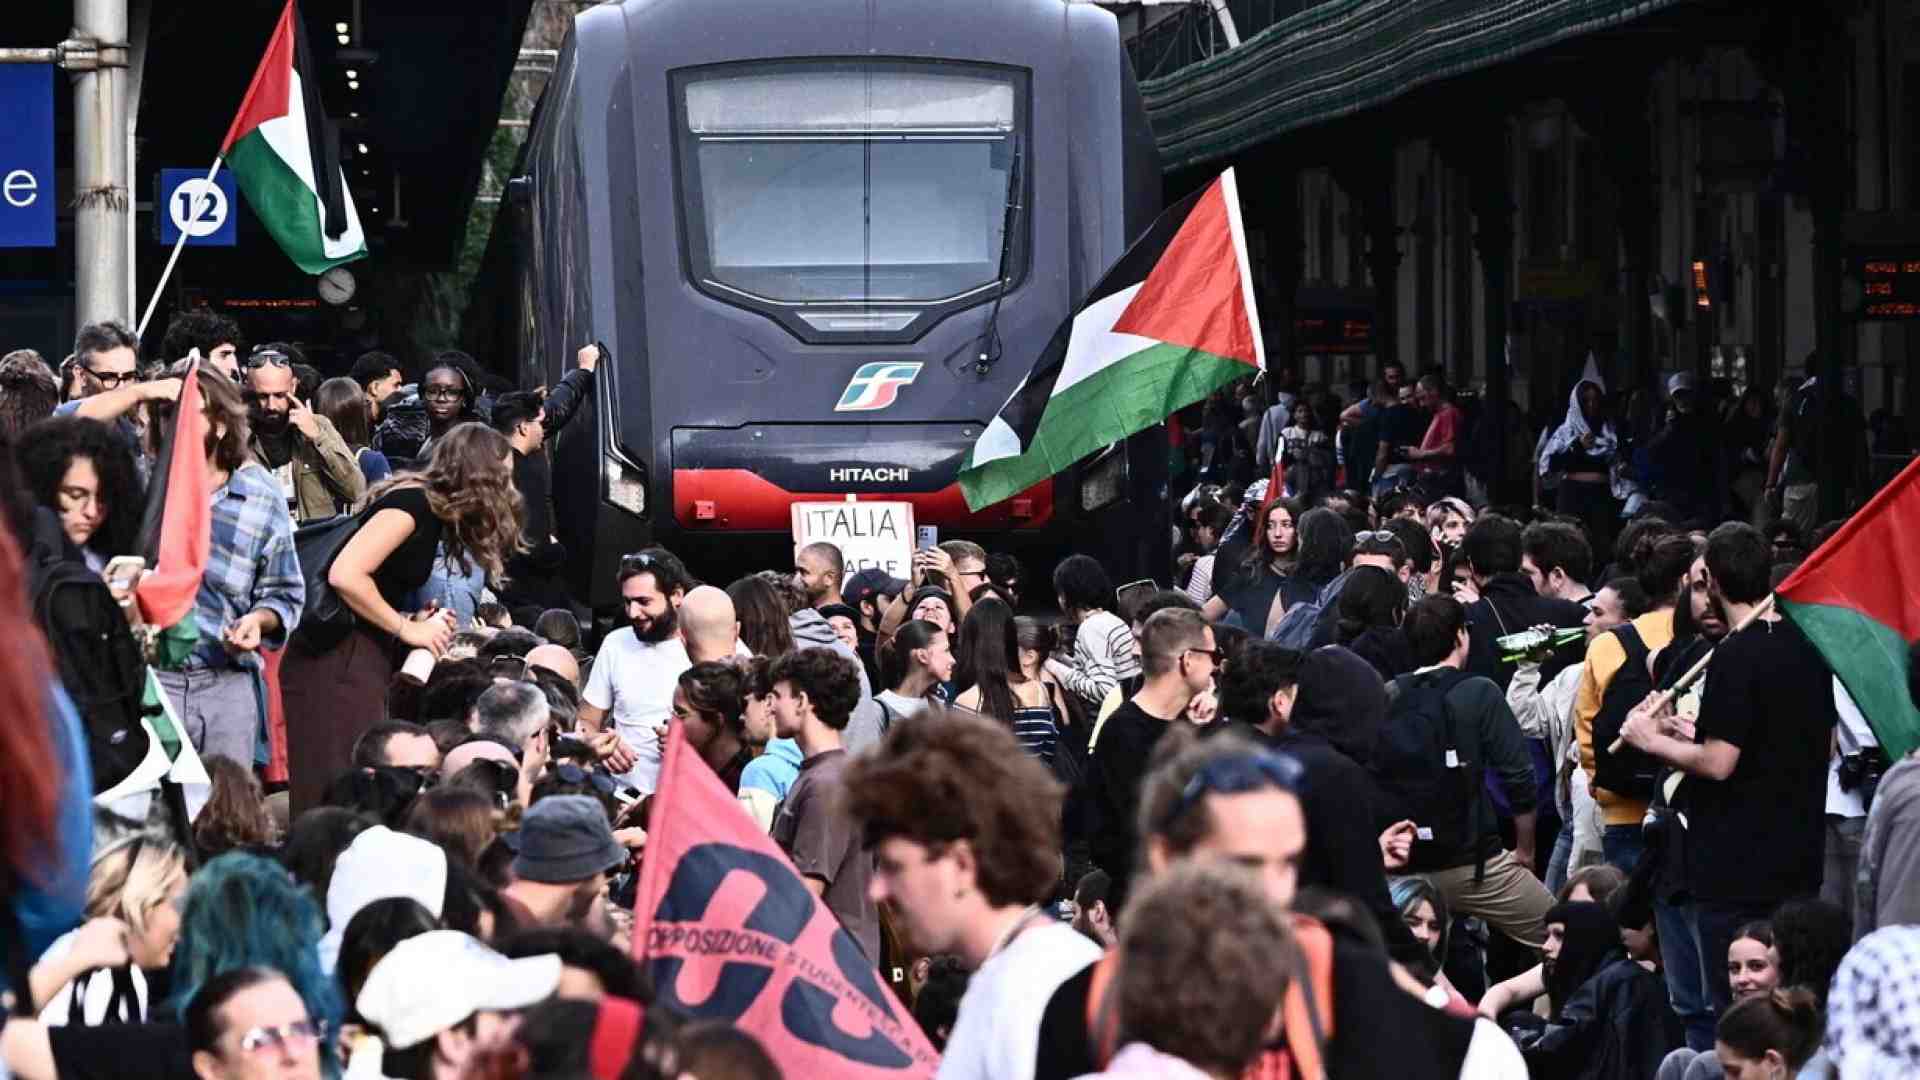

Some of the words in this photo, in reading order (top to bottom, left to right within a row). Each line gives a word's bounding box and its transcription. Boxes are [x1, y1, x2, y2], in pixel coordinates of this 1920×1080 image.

[178, 192, 218, 223] 12
[830, 468, 909, 482] HITACHI
[806, 507, 898, 540] ITALIA
[648, 926, 777, 961] OPPOSIZIONE
